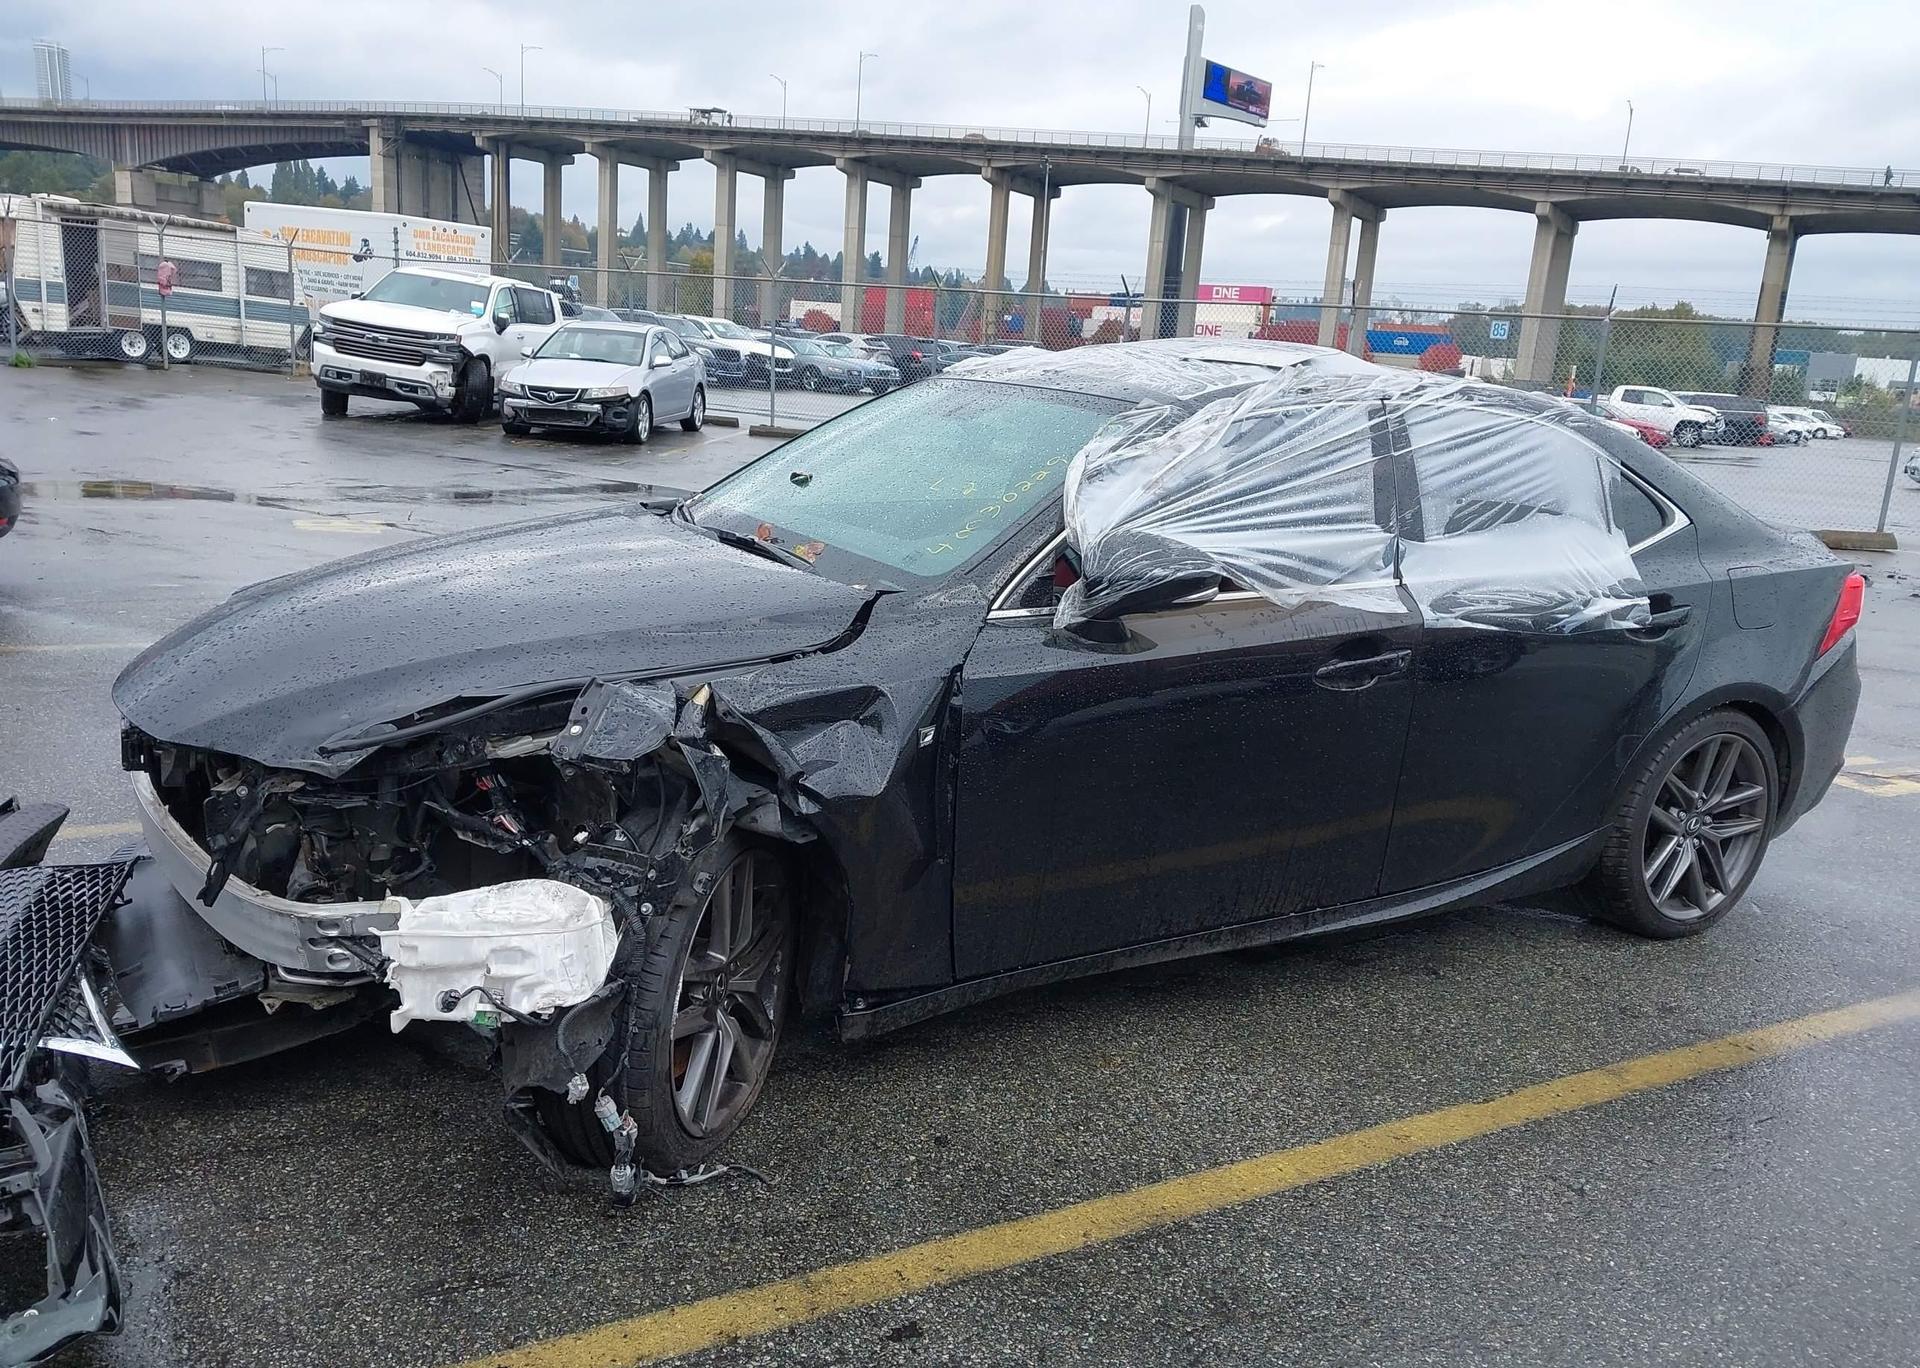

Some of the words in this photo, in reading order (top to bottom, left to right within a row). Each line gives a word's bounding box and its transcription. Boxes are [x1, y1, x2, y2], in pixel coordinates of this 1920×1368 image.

[301, 228, 351, 247] EXCAVATION
[432, 231, 476, 246] EXCAVATION
[422, 242, 474, 257] LANDSCAPING
[292, 249, 348, 266] ANDSCAPING
[1212, 287, 1240, 298] ONE
[1195, 324, 1222, 336] ONE
[1492, 323, 1506, 337] 85
